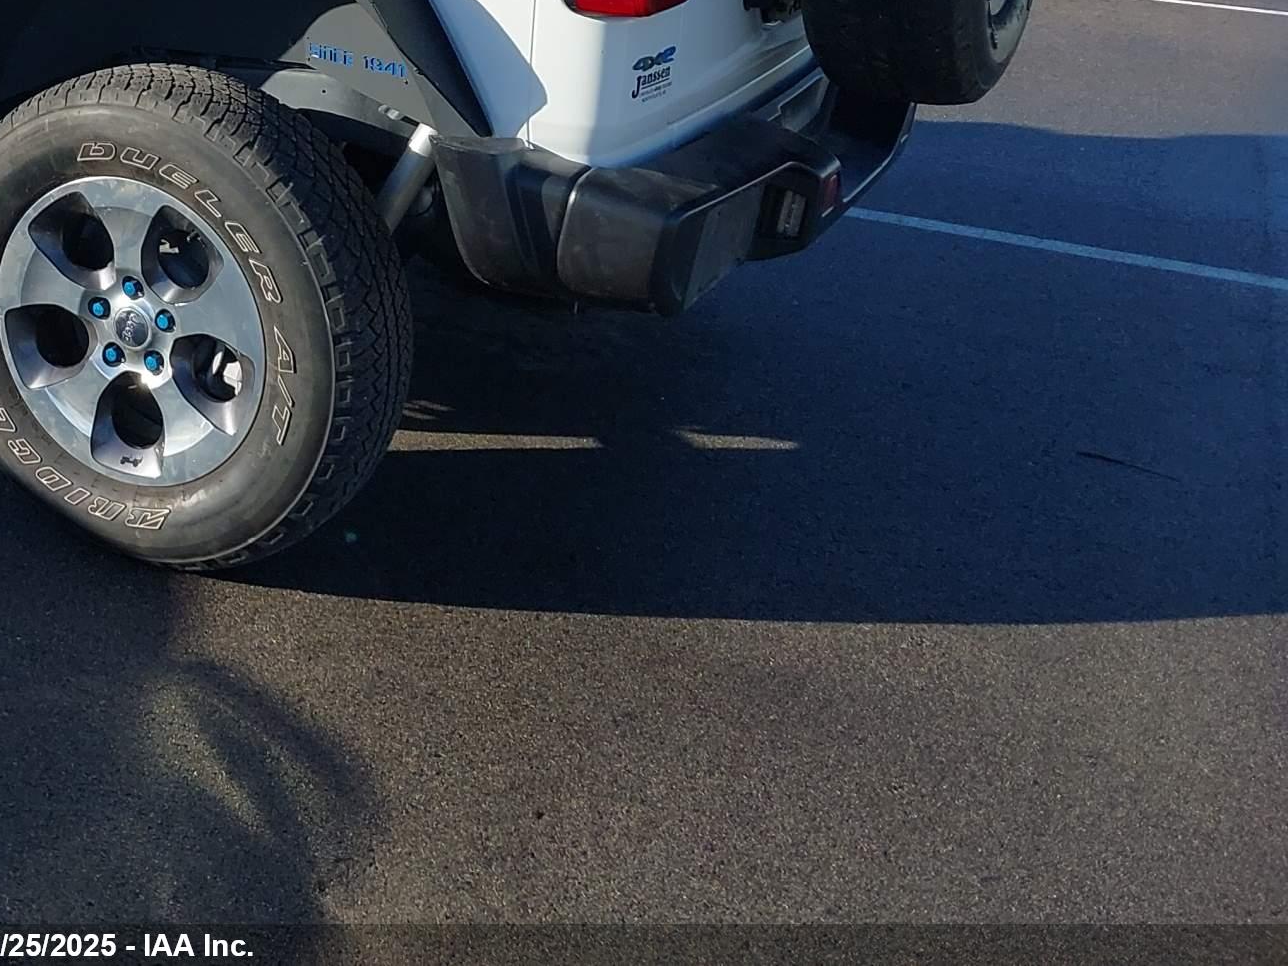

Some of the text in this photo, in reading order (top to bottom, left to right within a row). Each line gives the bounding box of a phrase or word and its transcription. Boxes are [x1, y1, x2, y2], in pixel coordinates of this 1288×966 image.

[363, 55, 407, 78] 1941
[632, 66, 671, 99] Janssen
[77, 141, 296, 446] DUELER A/T
